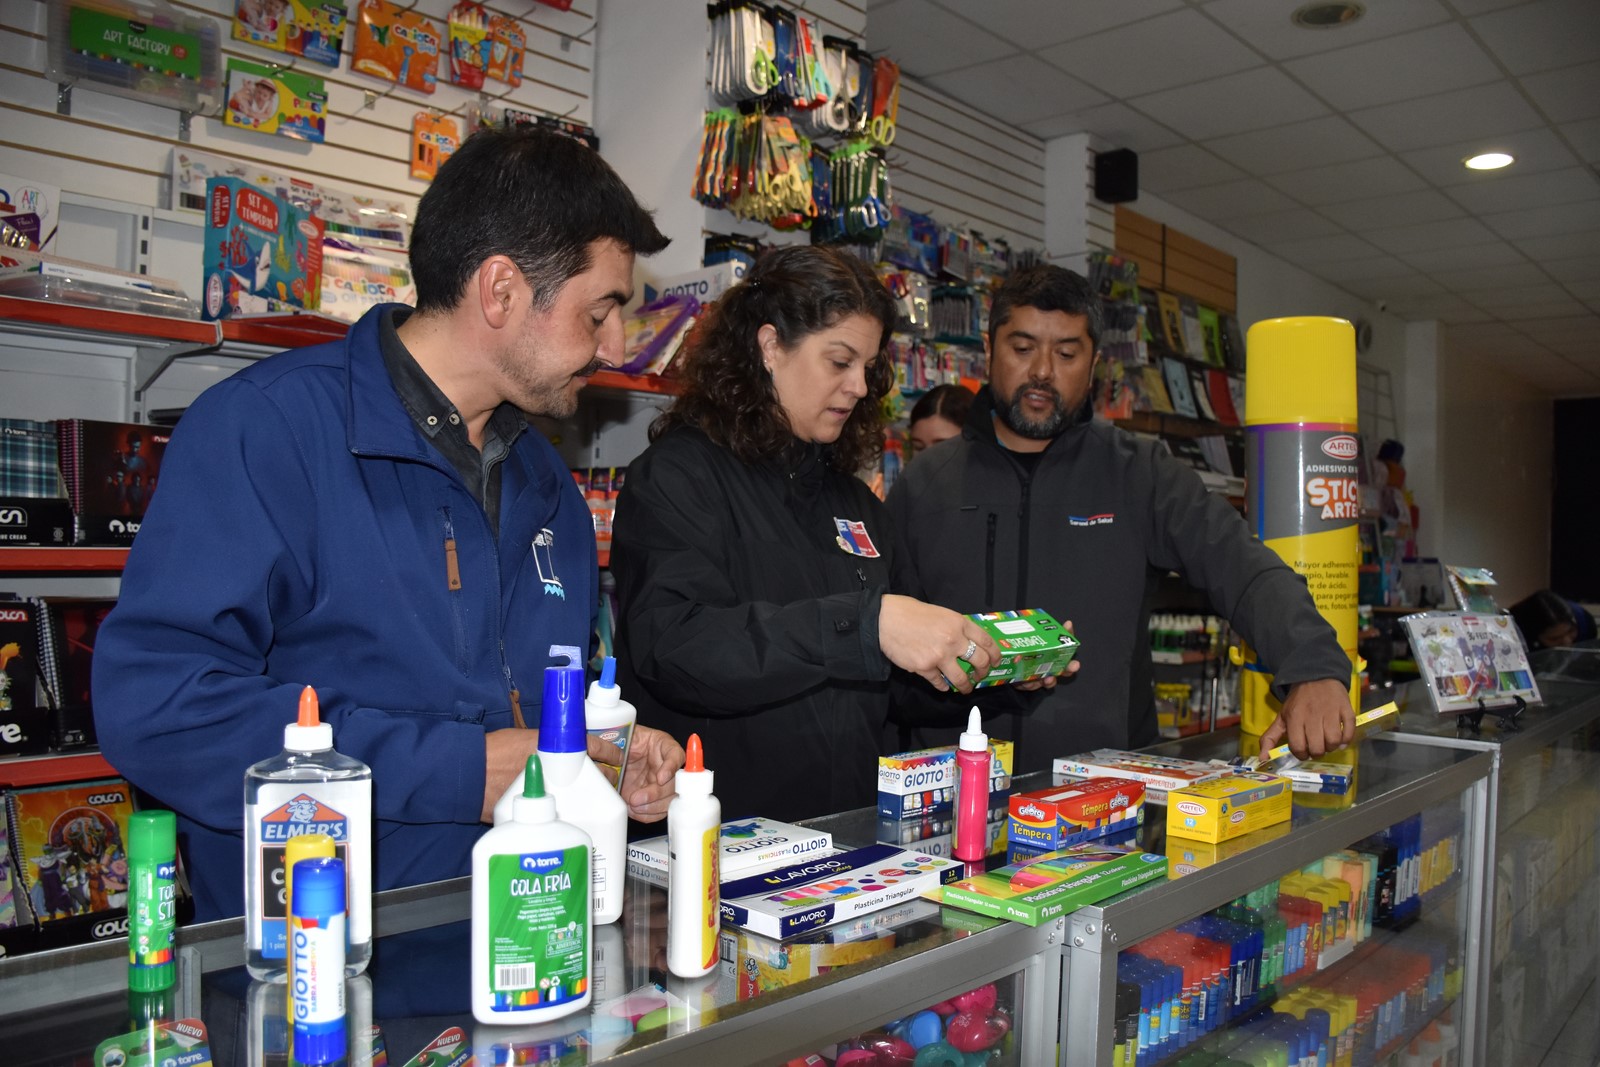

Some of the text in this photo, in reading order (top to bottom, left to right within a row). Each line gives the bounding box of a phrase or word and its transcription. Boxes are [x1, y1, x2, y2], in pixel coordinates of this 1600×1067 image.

[393, 23, 438, 45] CARIOCA
[103, 29, 171, 56] ART FACTORY
[420, 131, 456, 146] CARIOCA
[22, 189, 39, 204] ART
[248, 193, 261, 209] SET
[335, 277, 397, 297] CARIOCA
[663, 280, 709, 297] GIOTTO
[1305, 464, 1347, 473] ADHESIVO
[1294, 561, 1320, 570] Mayor
[1316, 593, 1334, 602] para
[879, 769, 901, 780] GIOTTO
[1062, 763, 1089, 775] CARIOCA
[904, 769, 944, 788] GIOTTO
[1081, 801, 1109, 816] Témpera
[1180, 803, 1203, 813] ARTEL
[265, 822, 344, 839] ELMER'S
[1012, 823, 1052, 841] Témpera
[726, 836, 789, 853] GIOTTO
[792, 837, 828, 854] GIOTTO
[949, 869, 955, 877] 12
[511, 871, 572, 896] COLA FRÍA
[853, 886, 915, 911] Plasticina Triangular
[793, 909, 827, 926] LAVORO
[294, 931, 308, 1020] GIOTTO
[176, 1023, 203, 1037] NUEVO
[437, 1033, 461, 1046] NUEVO
[178, 1052, 204, 1064] torre
